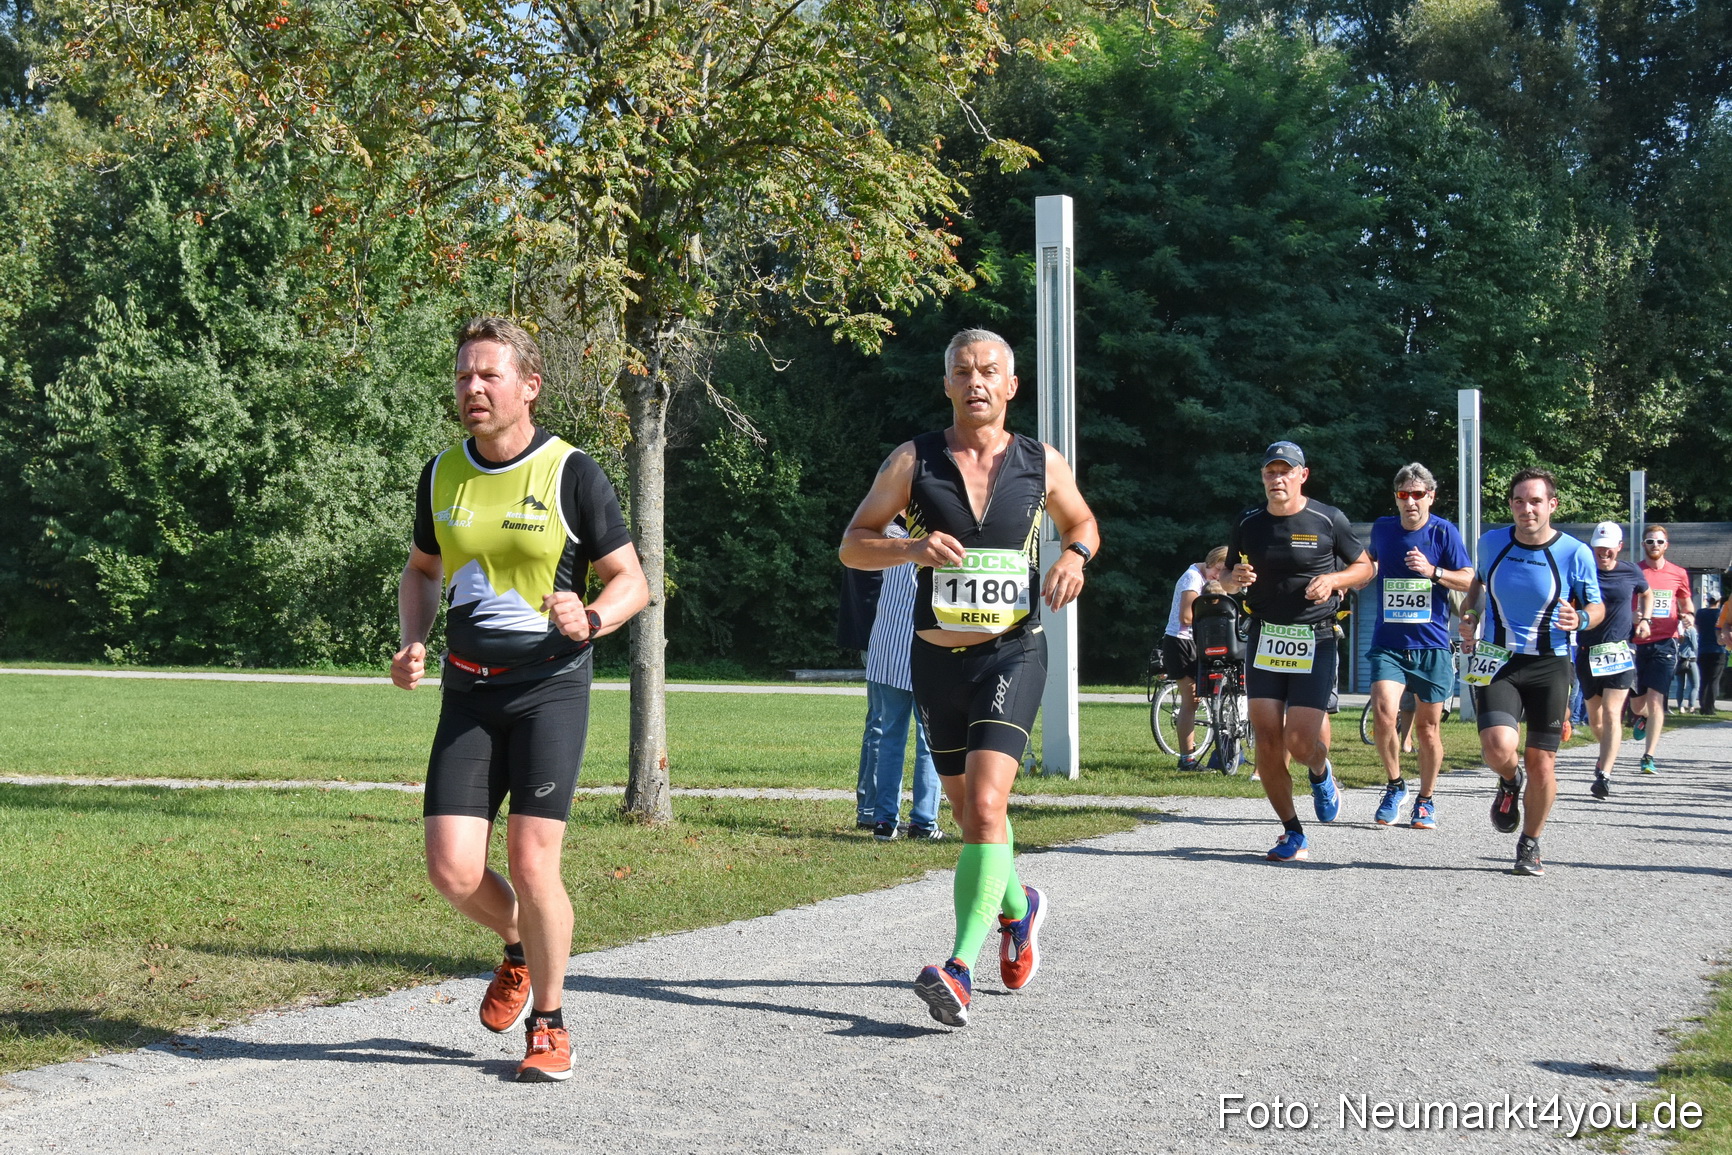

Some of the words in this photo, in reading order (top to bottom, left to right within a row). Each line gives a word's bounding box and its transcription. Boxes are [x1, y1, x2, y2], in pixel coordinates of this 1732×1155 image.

[501, 520, 545, 532] Runners
[943, 553, 1017, 569] OCK
[945, 578, 1018, 604] 1180
[1386, 581, 1424, 590] BOCK
[1388, 594, 1426, 608] 2548
[961, 613, 1000, 623] RENE
[1266, 624, 1308, 637] BOCK
[1266, 639, 1308, 656] 1009
[1270, 658, 1297, 667] PETER
[1594, 652, 1626, 666] 2171
